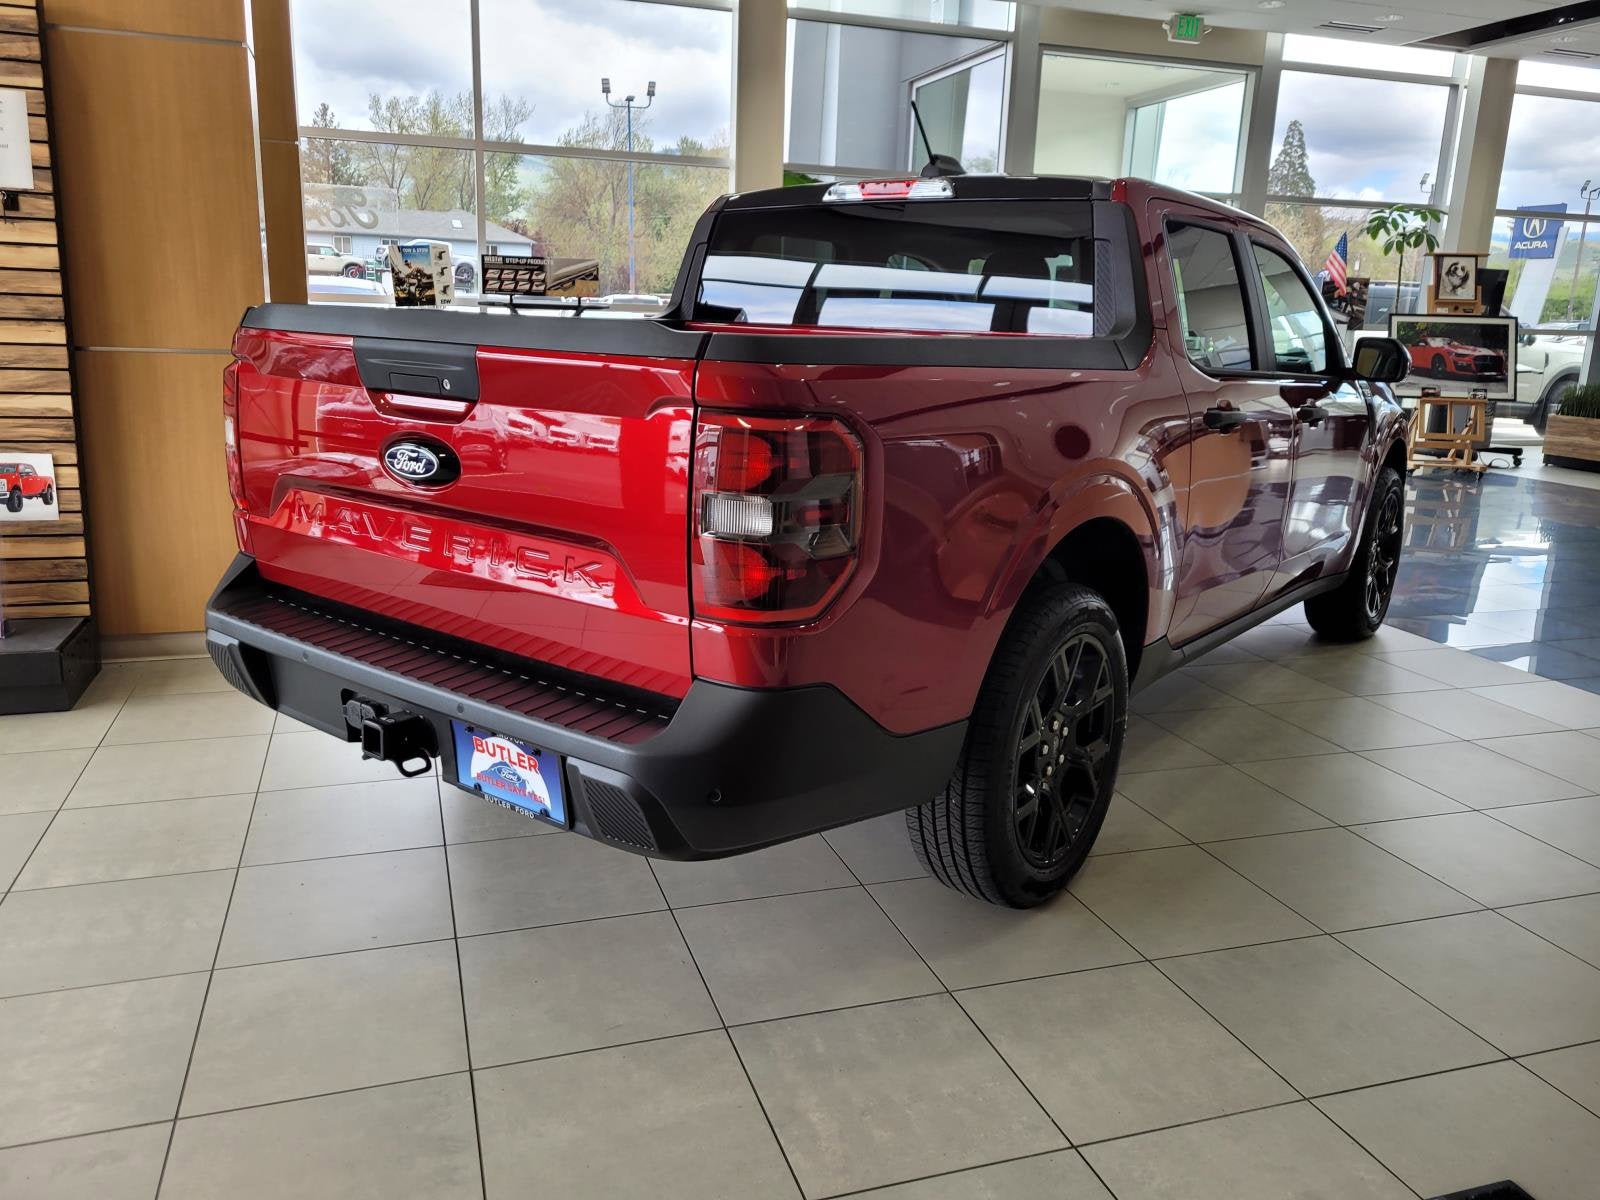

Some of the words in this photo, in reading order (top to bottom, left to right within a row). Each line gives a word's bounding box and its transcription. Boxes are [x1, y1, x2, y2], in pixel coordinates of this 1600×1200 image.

[1176, 15, 1200, 38] EXIT
[1514, 240, 1548, 249] ACURA
[393, 448, 428, 474] Ford
[295, 497, 605, 590] MAVERICK
[473, 736, 540, 774] BUTLER
[500, 766, 519, 781] Ford
[484, 794, 511, 810] BUTLER
[515, 806, 535, 819] FORD
